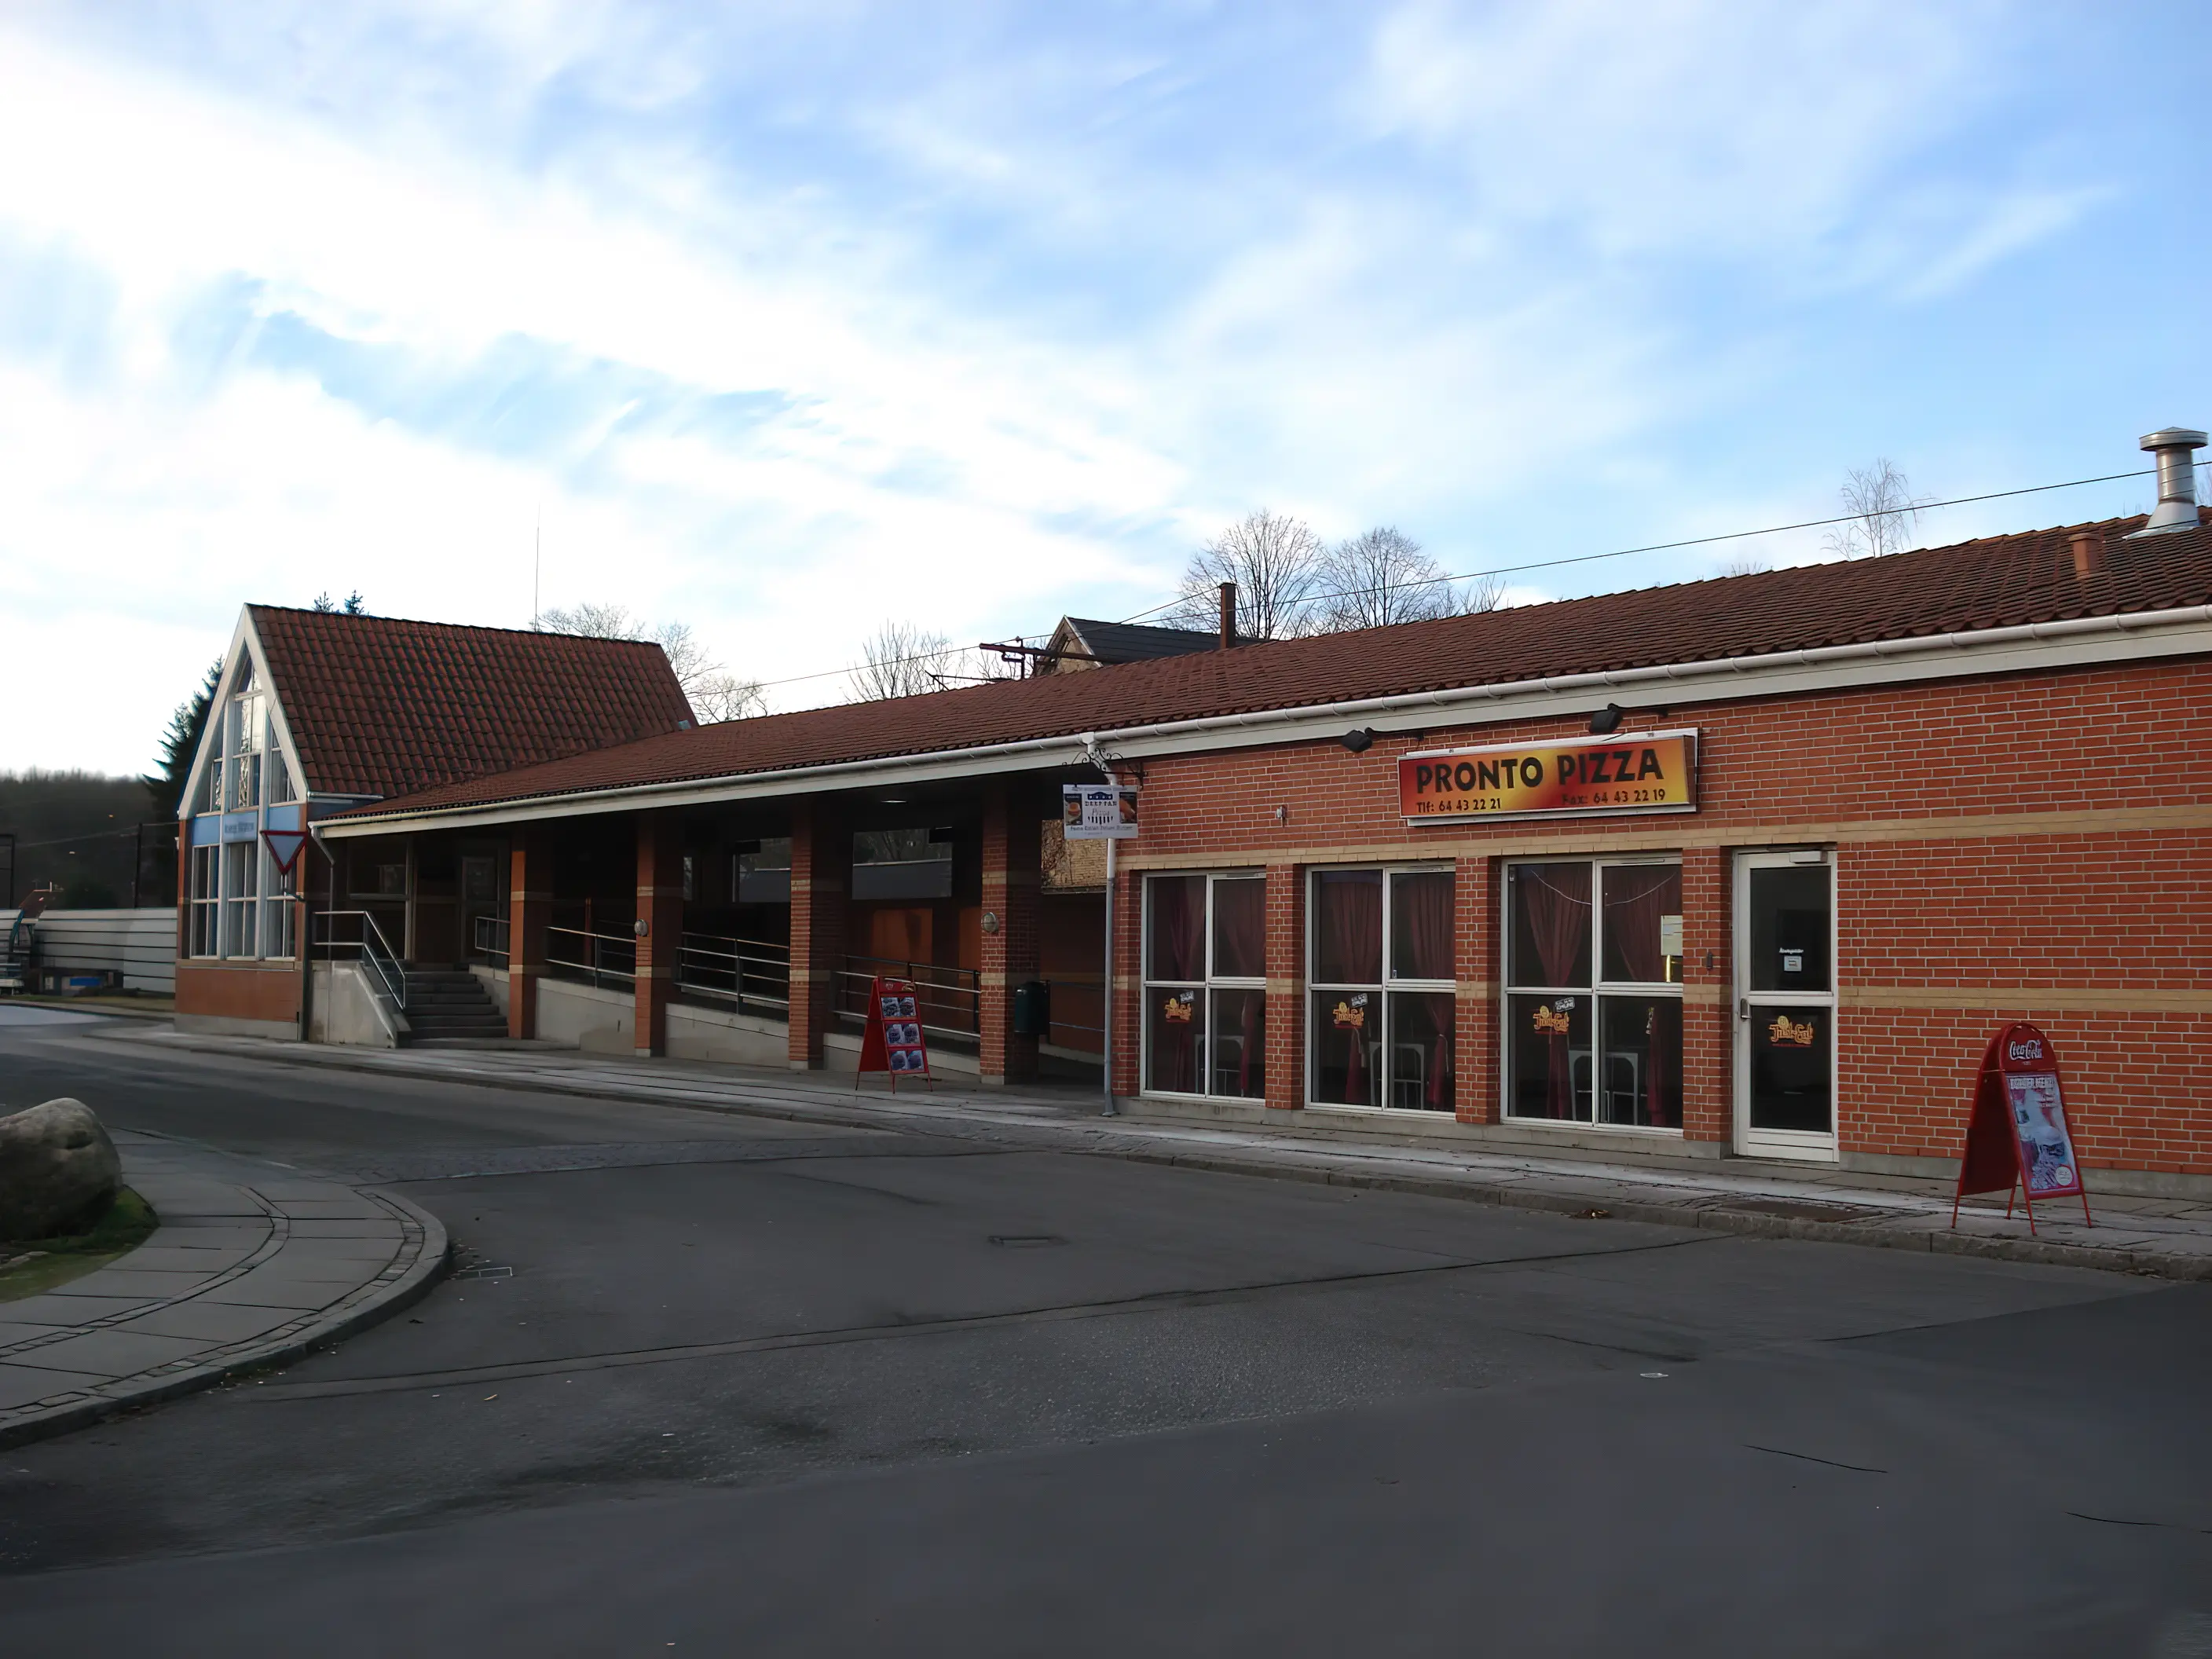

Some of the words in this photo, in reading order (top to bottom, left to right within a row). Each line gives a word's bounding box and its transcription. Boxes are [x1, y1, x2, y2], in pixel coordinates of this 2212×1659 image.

[1416, 756, 1544, 794] PRONTO
[1557, 749, 1664, 785] PIZZA
[1562, 794, 1588, 805] Fax:
[1593, 792, 1608, 803] 64
[1613, 790, 1628, 803] 43
[1634, 789, 1649, 802] 22
[1653, 788, 1665, 800] 19
[1416, 802, 1435, 813] Tlf:
[1439, 800, 1452, 811] 64
[1456, 799, 1469, 811] 43
[1473, 798, 1486, 810] 22
[1490, 798, 1501, 809] 21
